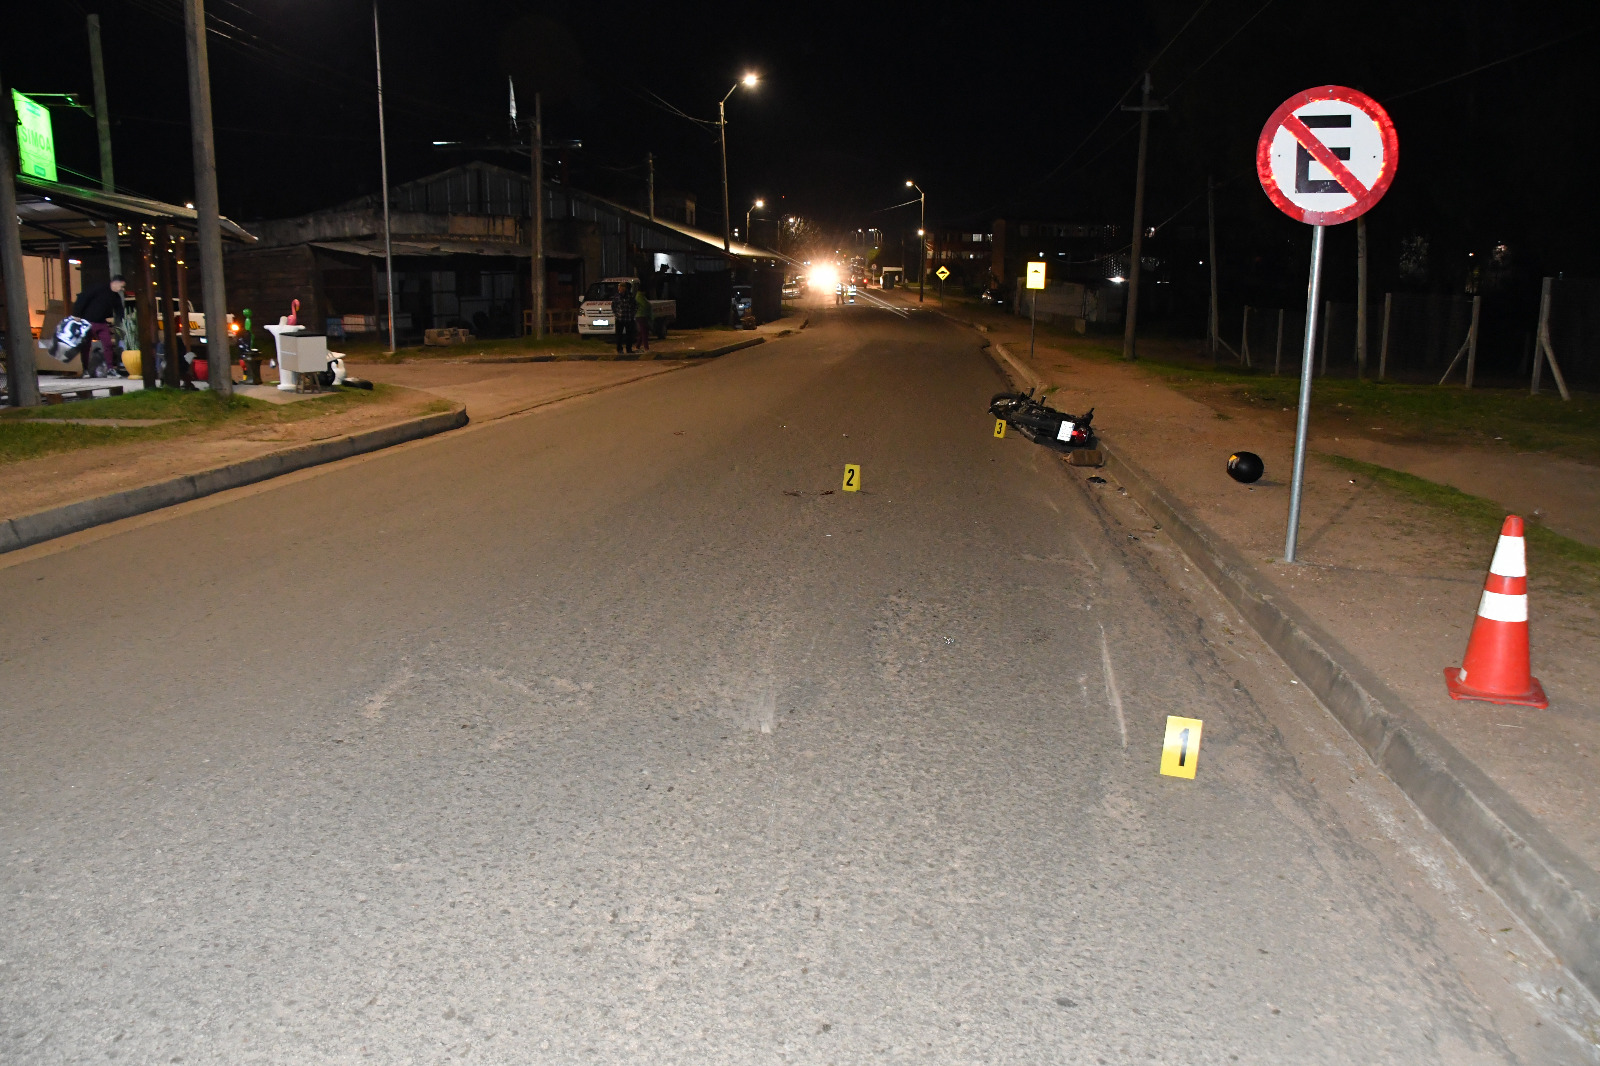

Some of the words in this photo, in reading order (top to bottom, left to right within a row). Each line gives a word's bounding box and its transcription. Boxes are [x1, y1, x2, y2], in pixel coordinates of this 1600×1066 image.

[21, 125, 52, 153] SIMOA
[1295, 115, 1352, 194] E
[996, 422, 1003, 435] 3
[846, 468, 855, 487] 2
[1178, 728, 1190, 767] 1
